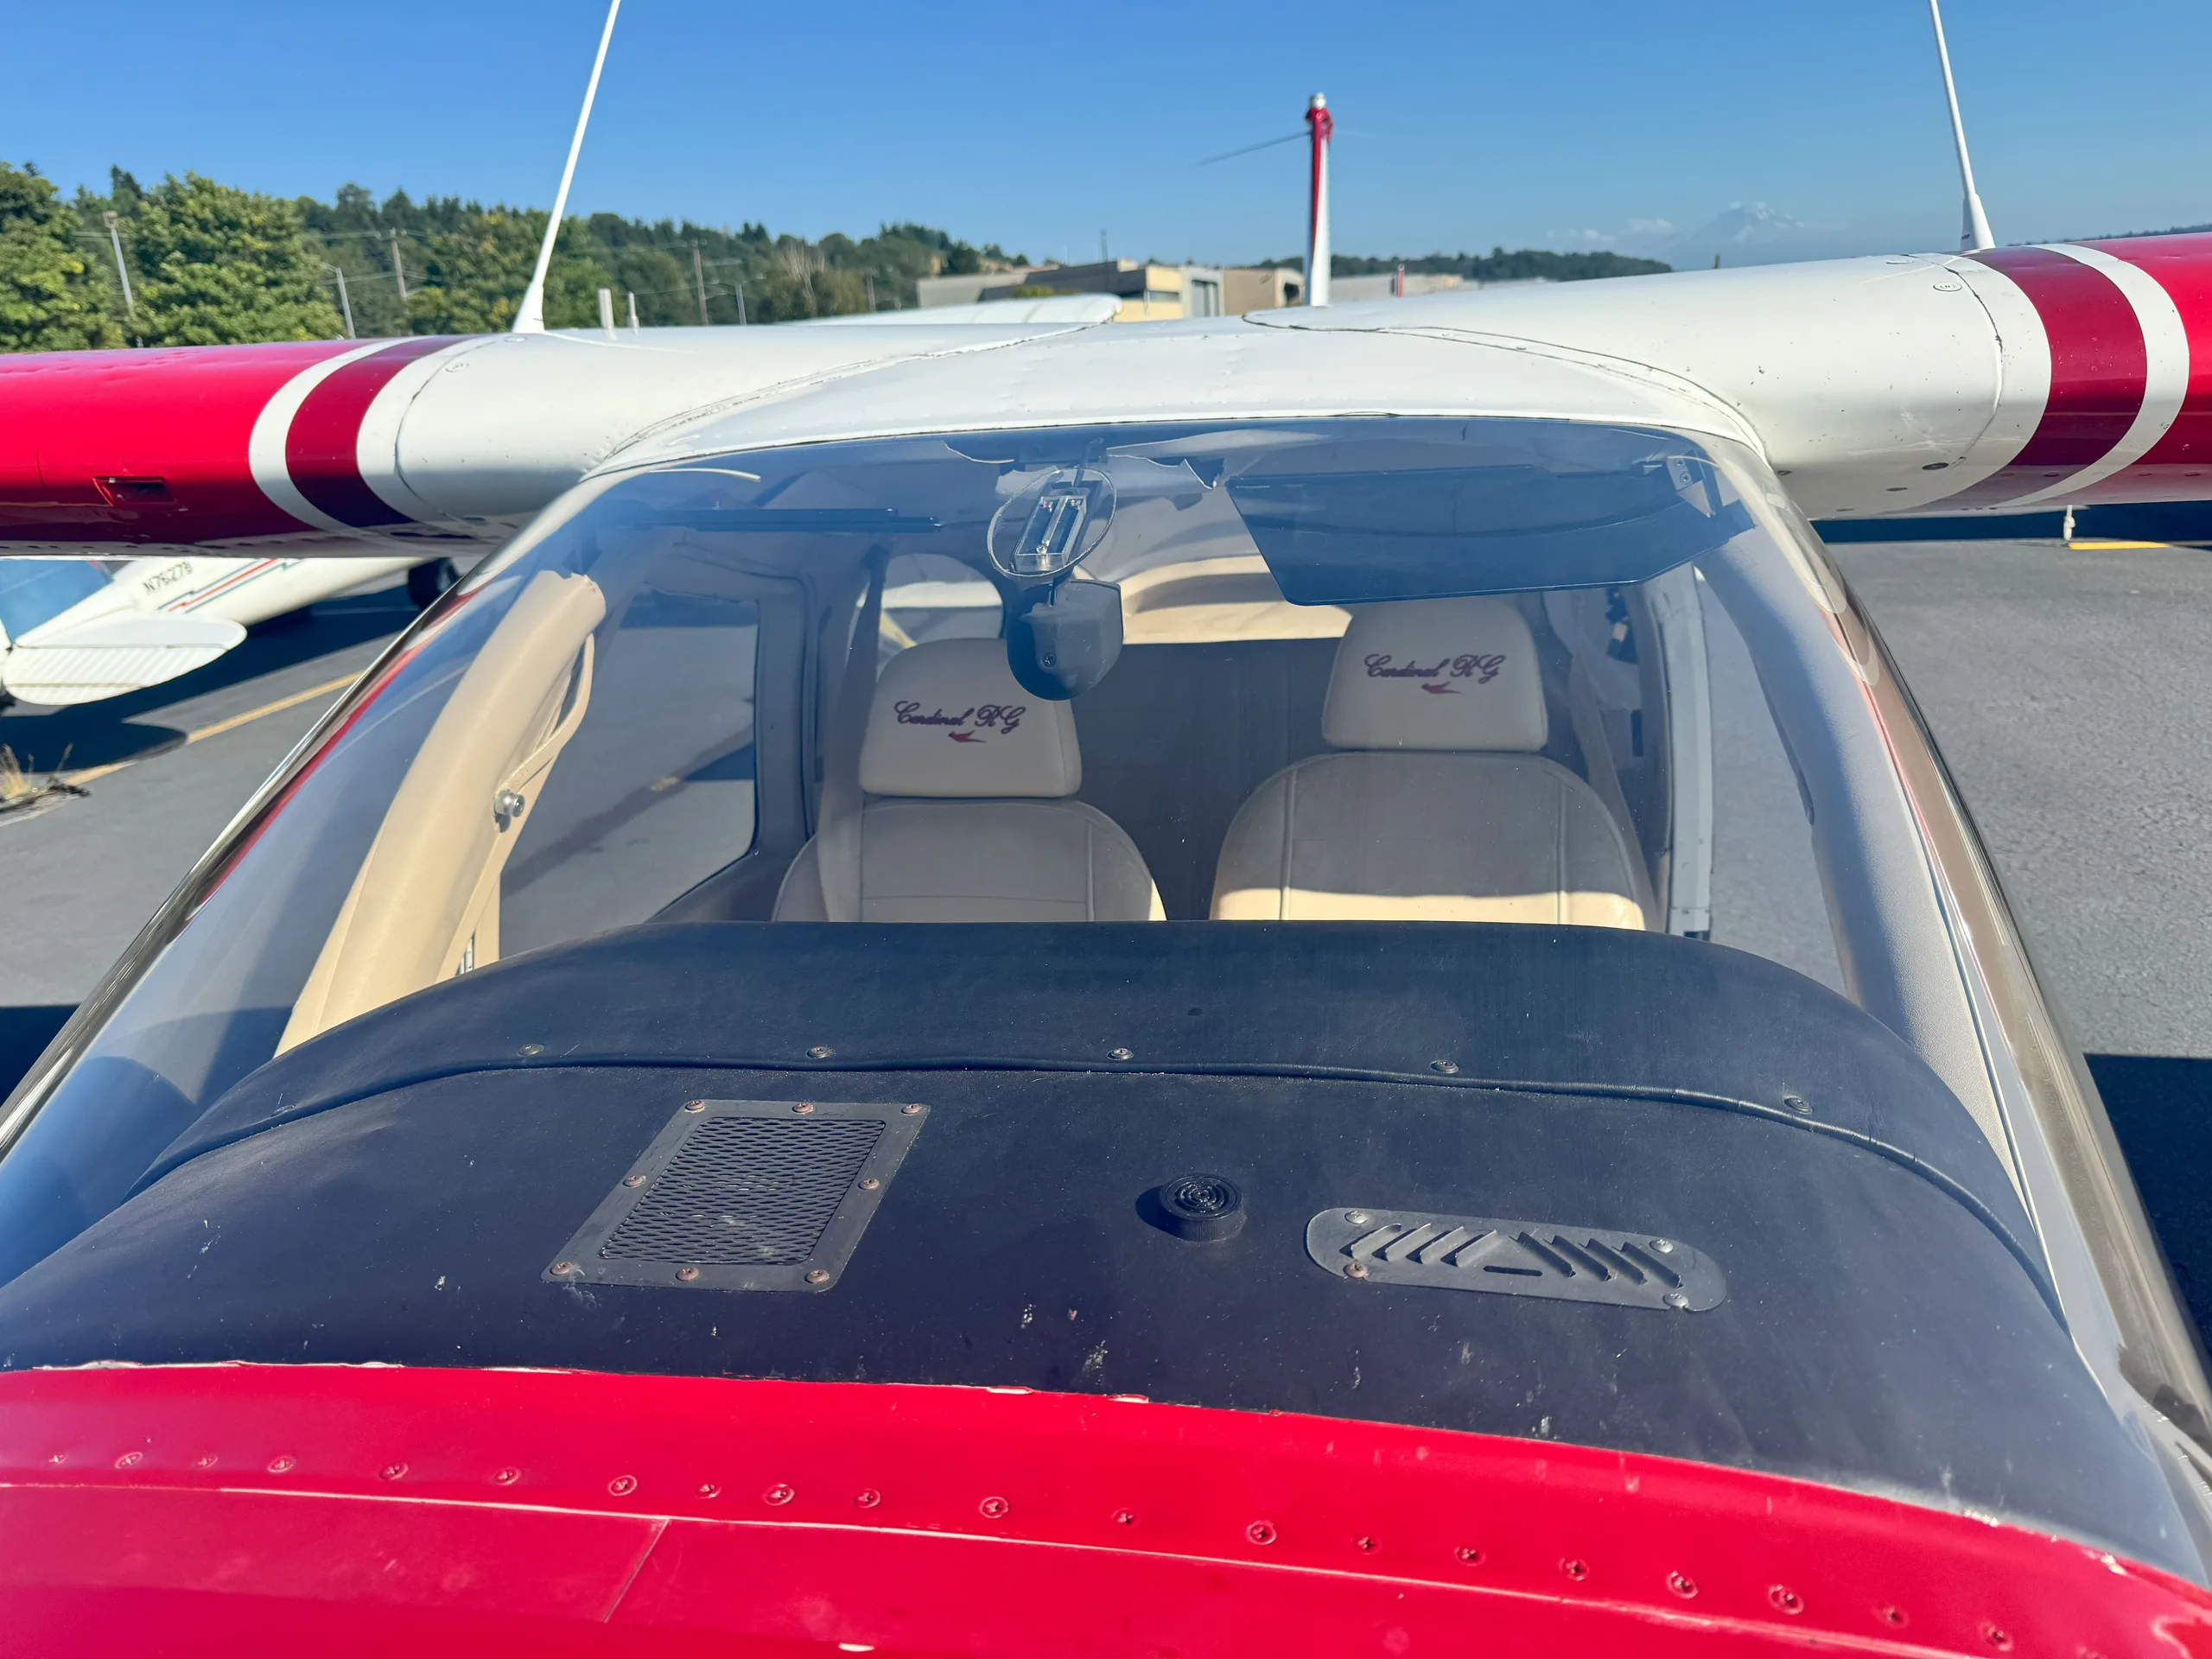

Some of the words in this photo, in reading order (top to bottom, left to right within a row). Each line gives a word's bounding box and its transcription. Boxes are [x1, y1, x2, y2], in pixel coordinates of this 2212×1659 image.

[1364, 653, 1451, 678] Cardinal
[1450, 654, 1506, 685] RG
[894, 701, 975, 726] Cardinal
[975, 704, 1026, 734] RG
